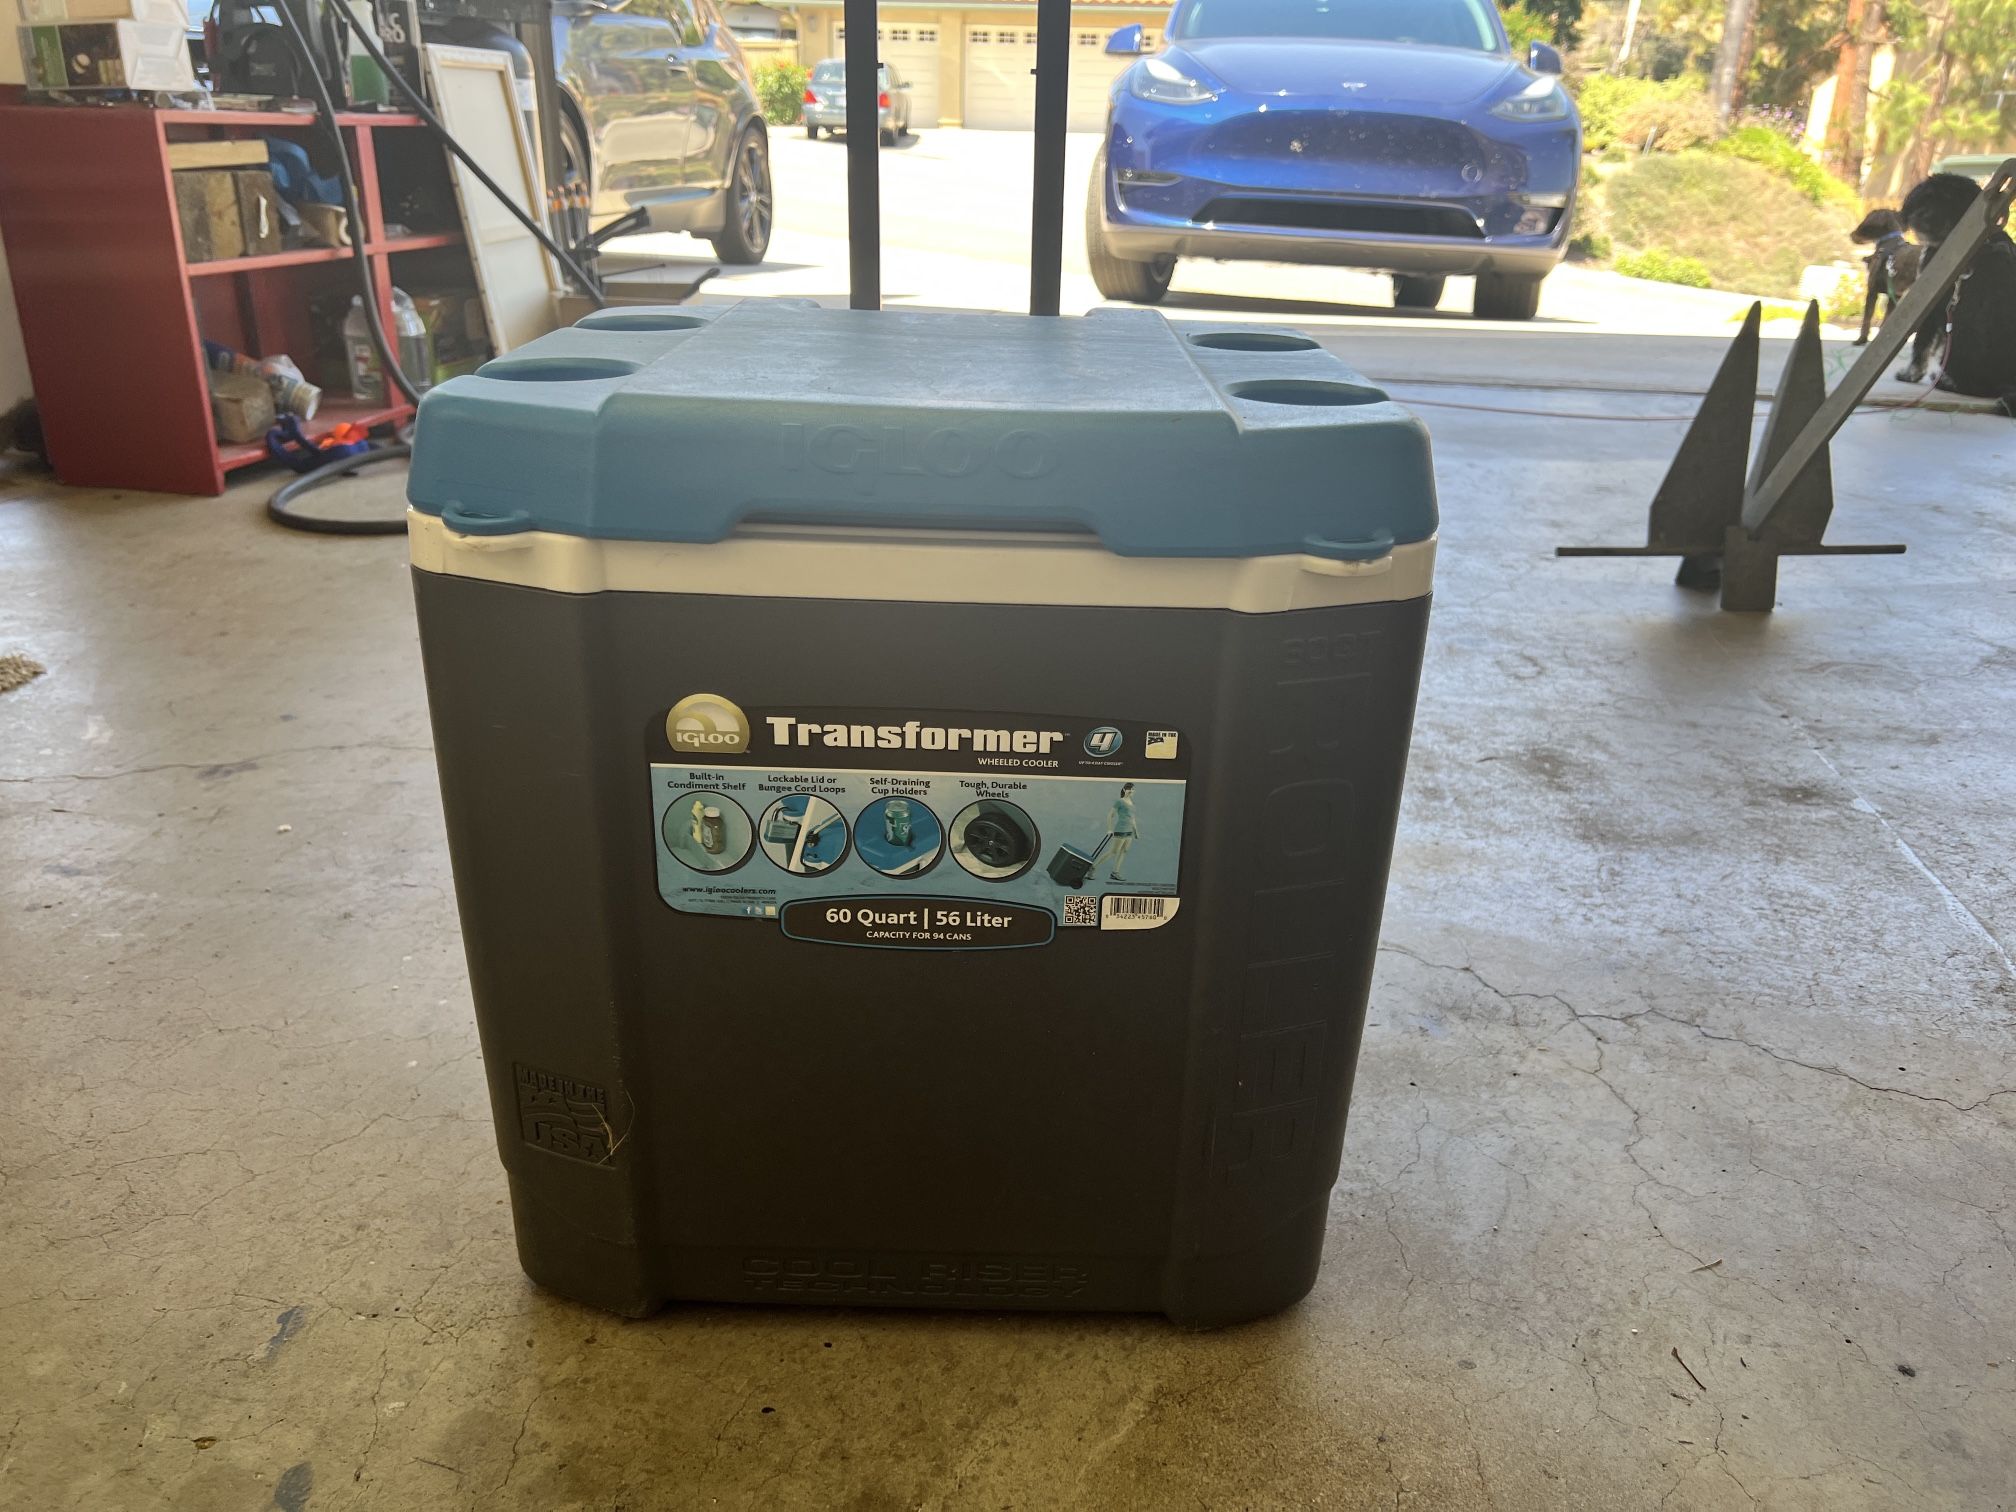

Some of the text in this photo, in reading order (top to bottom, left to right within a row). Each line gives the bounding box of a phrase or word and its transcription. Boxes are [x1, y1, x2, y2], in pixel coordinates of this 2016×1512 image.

[781, 422, 1062, 495] IGLOO
[676, 732, 740, 747] IGLOO
[766, 716, 1064, 754] Transformer
[978, 757, 1059, 768] WHEELED COOLER
[689, 772, 725, 781] Built-in
[767, 775, 809, 784] Lockable
[811, 775, 825, 784] Lid
[667, 781, 746, 791] Condiment Shelf
[869, 777, 931, 789] Self-Draining
[959, 780, 1028, 790] Tough, Durable
[758, 784, 846, 795] Bungee Cord Loops
[871, 787, 928, 796] Cup Holders
[975, 790, 1010, 798] Wheels
[825, 908, 852, 924] 60
[857, 908, 918, 927] Quart
[935, 911, 961, 926] 56
[966, 911, 1013, 928] Liter
[866, 930, 972, 941] CAPACITY FOR 94 CANS
[521, 1066, 606, 1104] MADE IN THE
[525, 1118, 616, 1167] USA
[742, 1257, 1090, 1286] COOL RISER
